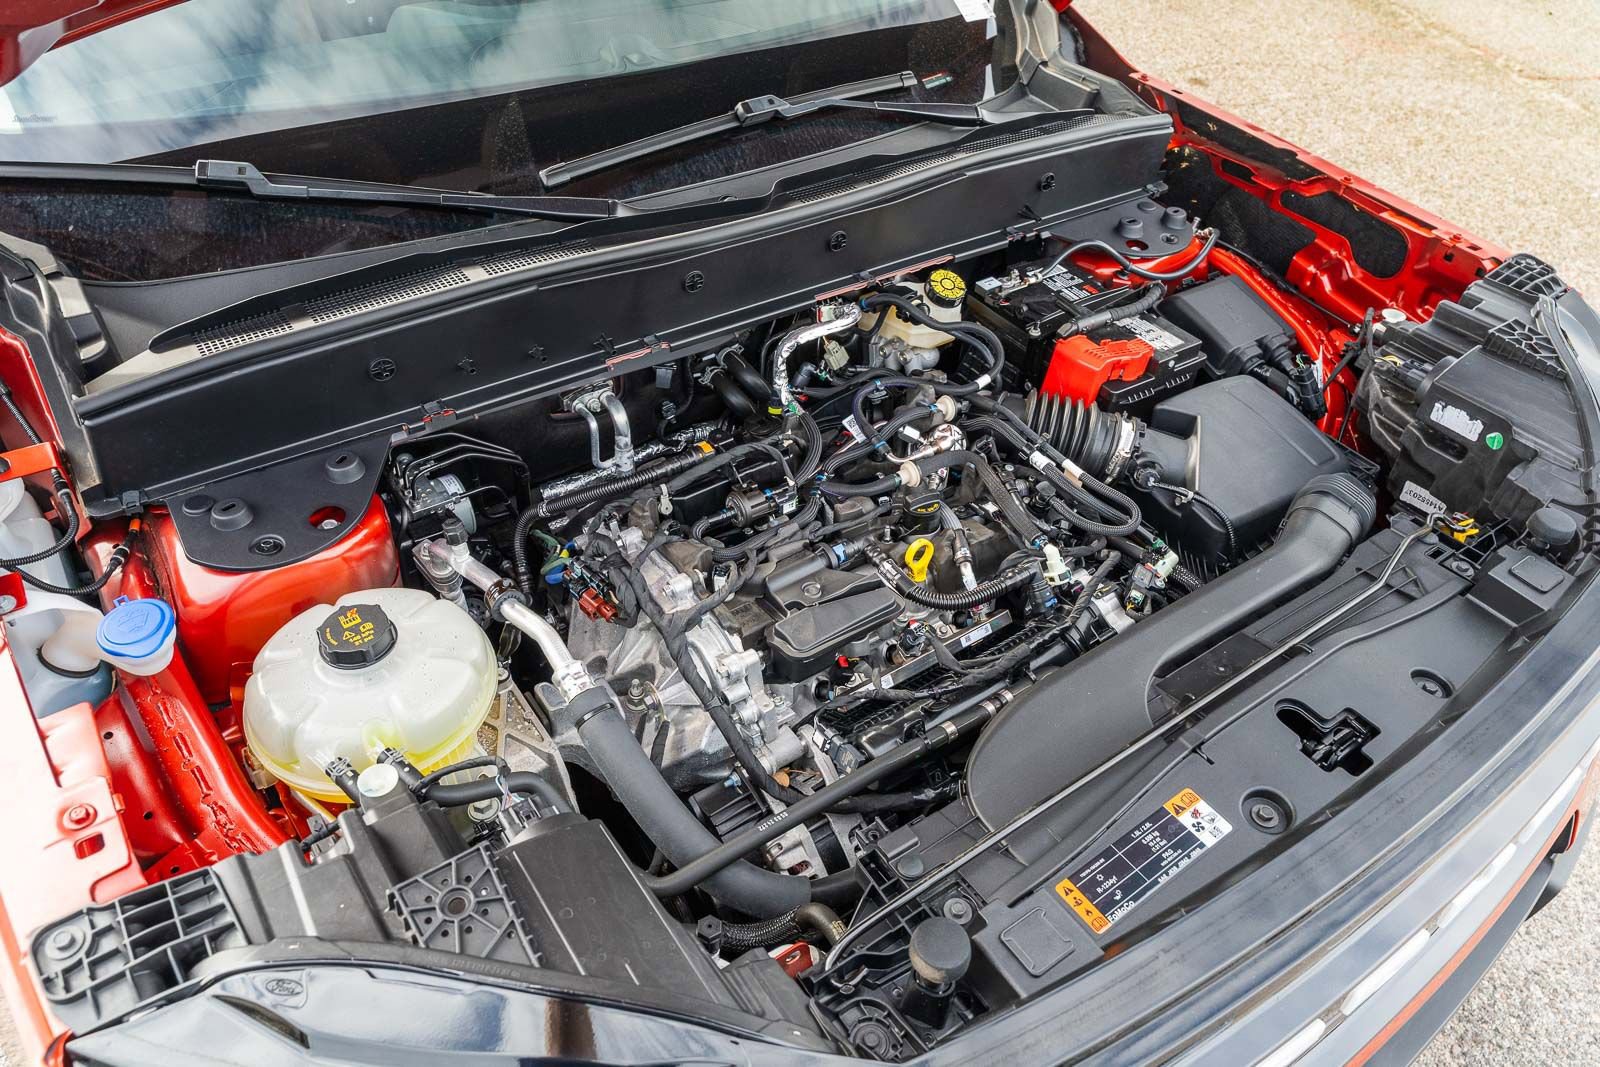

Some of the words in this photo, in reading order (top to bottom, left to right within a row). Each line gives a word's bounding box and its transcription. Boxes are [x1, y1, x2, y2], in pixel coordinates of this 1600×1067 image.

[1162, 849, 1173, 859] PAG
[1096, 875, 1117, 893] R-1234yf
[1107, 901, 1135, 923] FoMoCo
